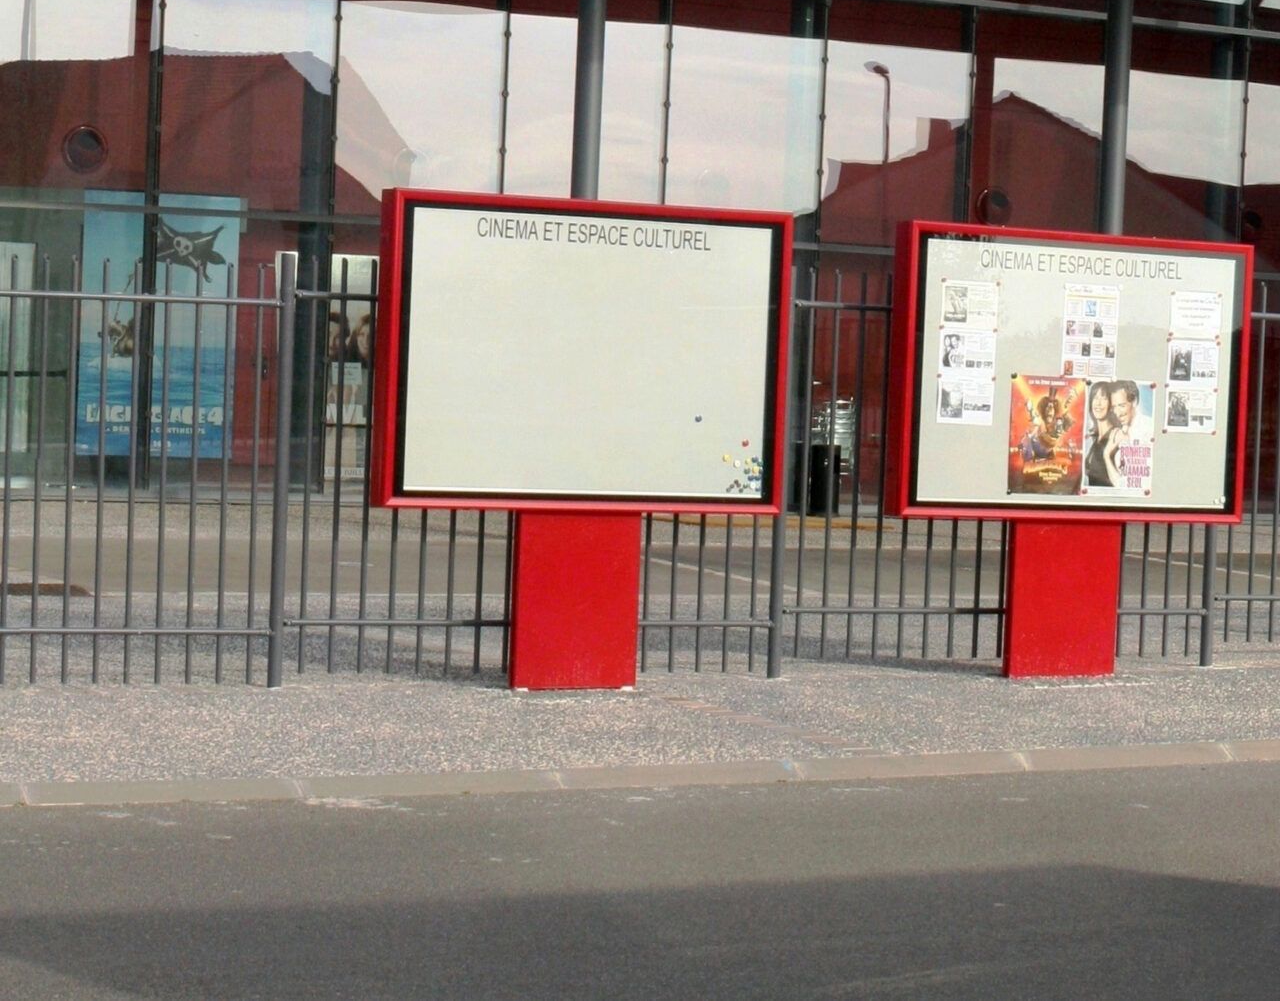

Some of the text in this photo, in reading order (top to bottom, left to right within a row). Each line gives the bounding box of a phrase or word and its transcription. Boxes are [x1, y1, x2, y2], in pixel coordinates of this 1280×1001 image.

[477, 217, 711, 251] CINEMA ET ESPACE CULTUREL
[980, 249, 1182, 280] CINEMA ET ESPACE CULTUREL
[207, 406, 224, 426] 4
